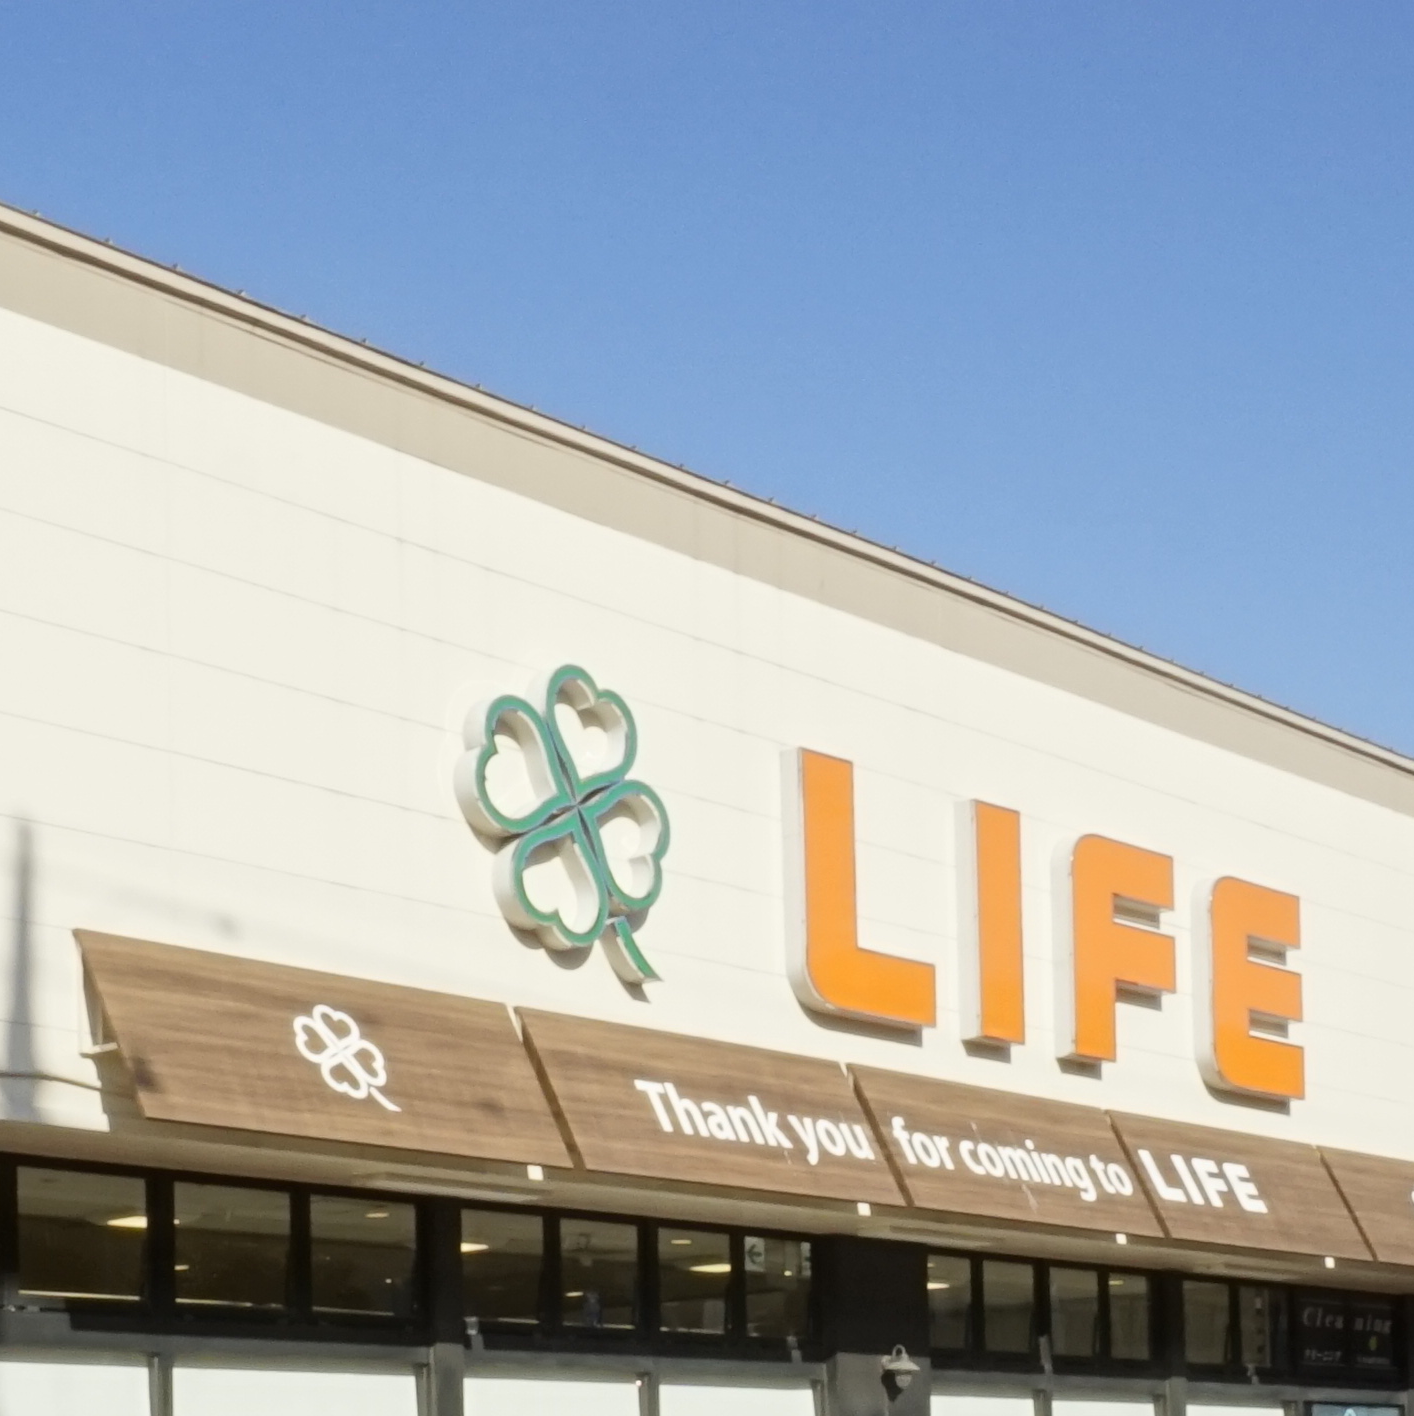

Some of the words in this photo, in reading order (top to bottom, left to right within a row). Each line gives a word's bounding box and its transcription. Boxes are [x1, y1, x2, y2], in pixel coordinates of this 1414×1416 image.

[792, 746, 1305, 1101] LIFE
[633, 1078, 793, 1149] Thank
[787, 1114, 876, 1166] you
[891, 1116, 956, 1171] for
[958, 1139, 1098, 1202] coming
[1089, 1154, 1134, 1197] to
[1138, 1148, 1269, 1214] LIFE
